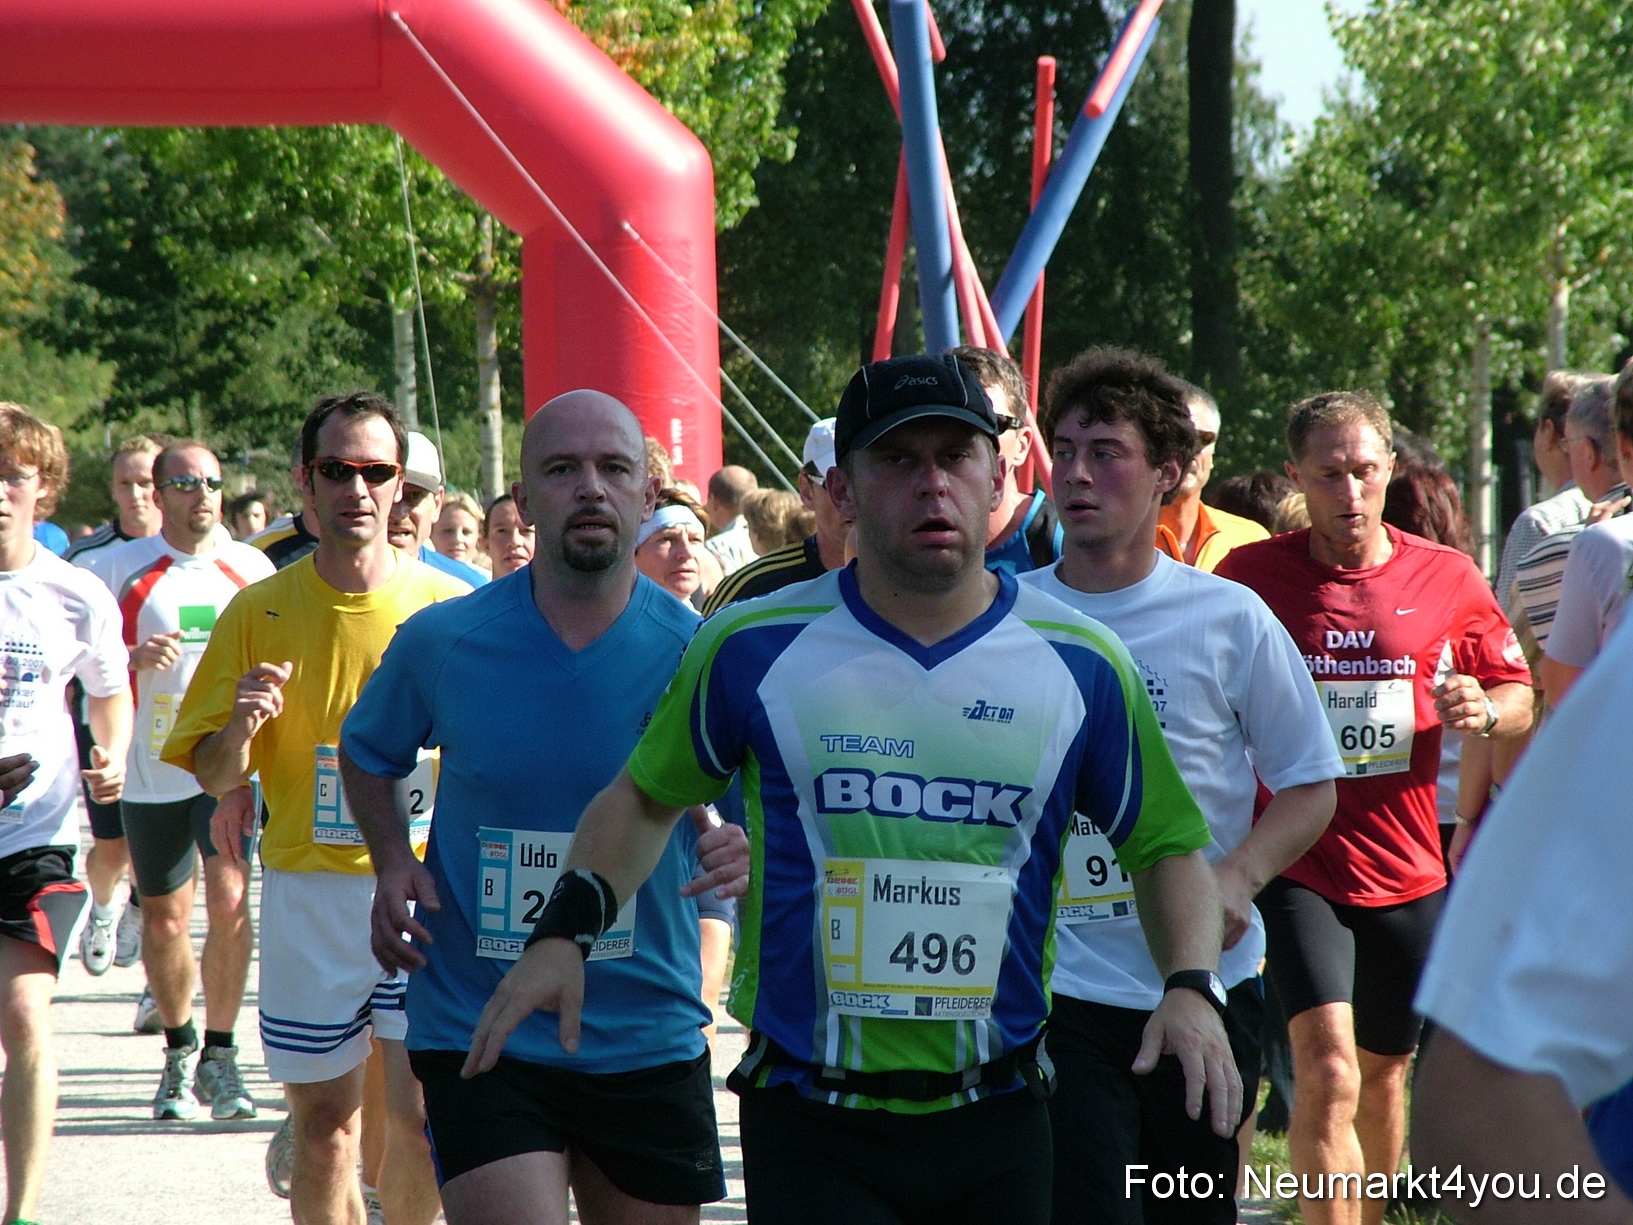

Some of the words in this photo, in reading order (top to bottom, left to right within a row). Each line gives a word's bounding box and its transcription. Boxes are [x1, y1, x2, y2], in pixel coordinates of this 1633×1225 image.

[1326, 630, 1375, 649] DAV
[1303, 655, 1416, 676] öthenbach
[1328, 690, 1378, 709] Harald
[820, 734, 915, 758] TEAM
[1340, 724, 1396, 750] 605
[320, 783, 327, 797] C
[814, 767, 1034, 828] BOCK
[409, 789, 424, 815] 2
[520, 843, 557, 868] Udo
[484, 878, 493, 896] B
[873, 873, 961, 906] Markus
[831, 919, 841, 940] B
[889, 931, 977, 975] 496
[831, 991, 890, 1009] BOCK
[934, 997, 991, 1009] PFLEIDERER
